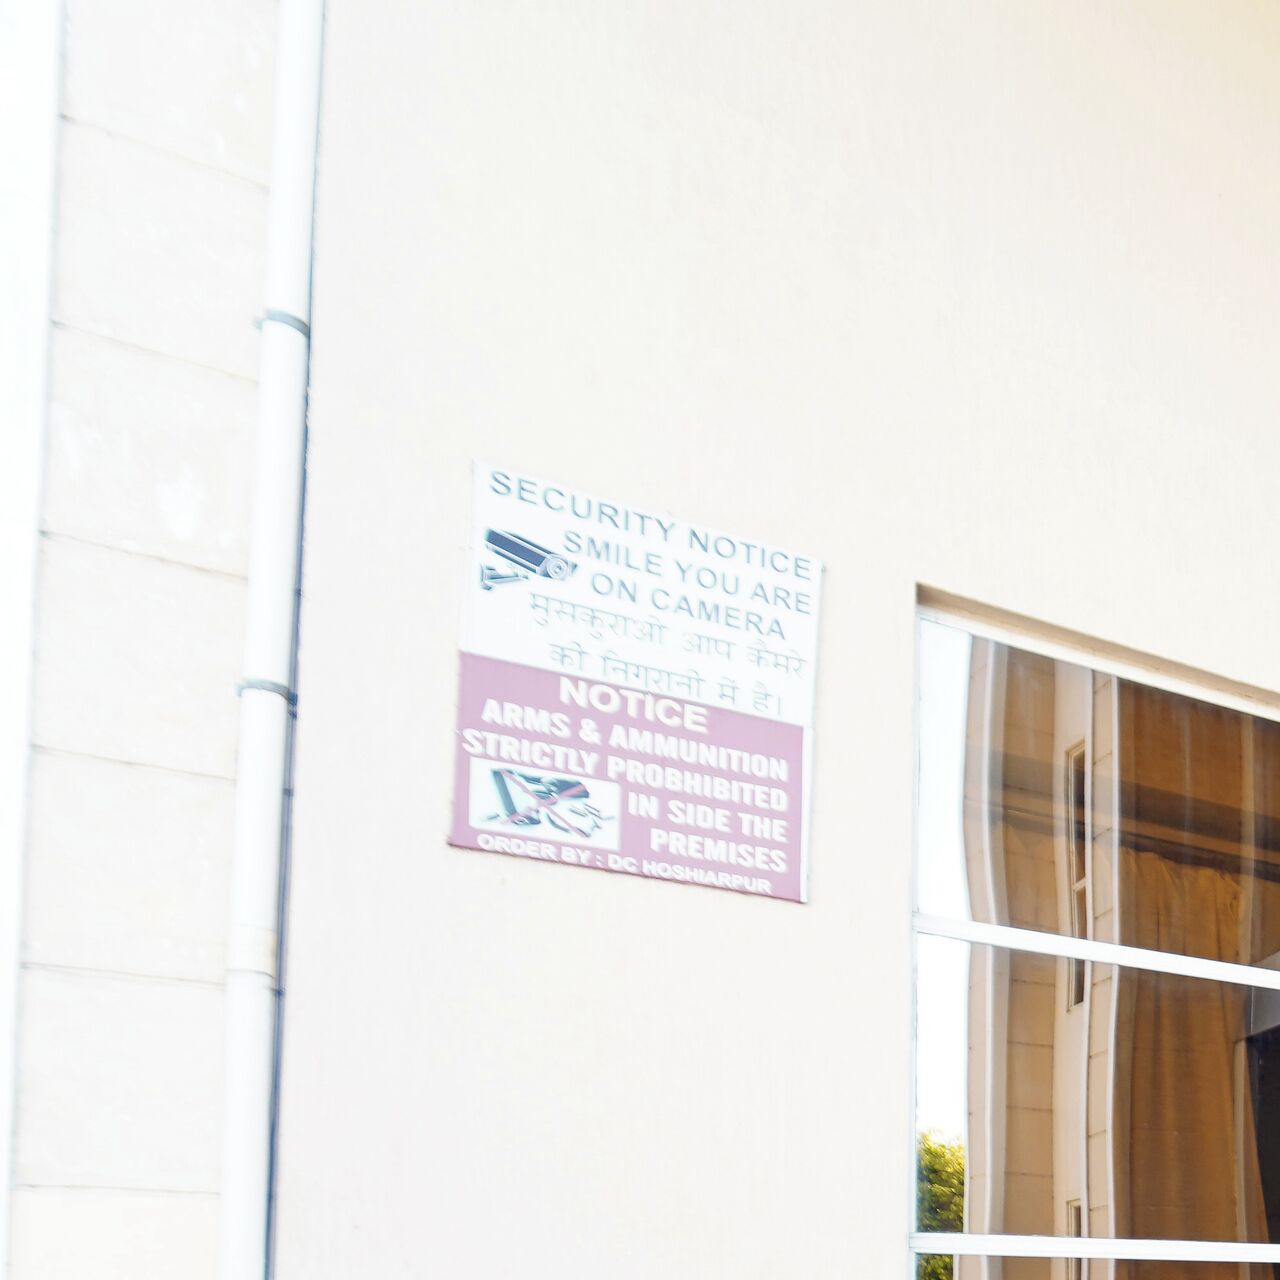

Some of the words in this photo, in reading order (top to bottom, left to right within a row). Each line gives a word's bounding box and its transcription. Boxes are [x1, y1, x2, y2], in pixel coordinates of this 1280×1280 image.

[489, 470, 677, 542] SECURITY
[688, 528, 813, 582] NOTICE
[563, 530, 663, 577] SMILE
[675, 560, 739, 595] YOU
[750, 582, 812, 615] ARE
[591, 572, 638, 603] ON
[651, 588, 786, 640] CAMERA
[529, 591, 669, 645] मुसकुराओ
[683, 631, 737, 661] आप
[746, 638, 808, 678] कैमरे
[549, 641, 588, 670] की
[601, 649, 704, 698] निगरानी
[718, 676, 742, 705] में
[559, 675, 710, 734] NOTICE
[462, 728, 600, 777] STRICTLY
[606, 755, 789, 812] PROBHIBITED
[481, 698, 572, 739] ARMS
[578, 717, 603, 746] &
[609, 725, 790, 783] AMMUNITION
[627, 792, 660, 820] IN
[667, 800, 731, 833] SIDE
[738, 812, 789, 843] THE
[650, 828, 788, 875] PREMISES
[476, 833, 560, 863] ORDER
[561, 847, 592, 866] BY
[608, 853, 638, 873] DC
[643, 859, 772, 895] HOSHIARPUR
